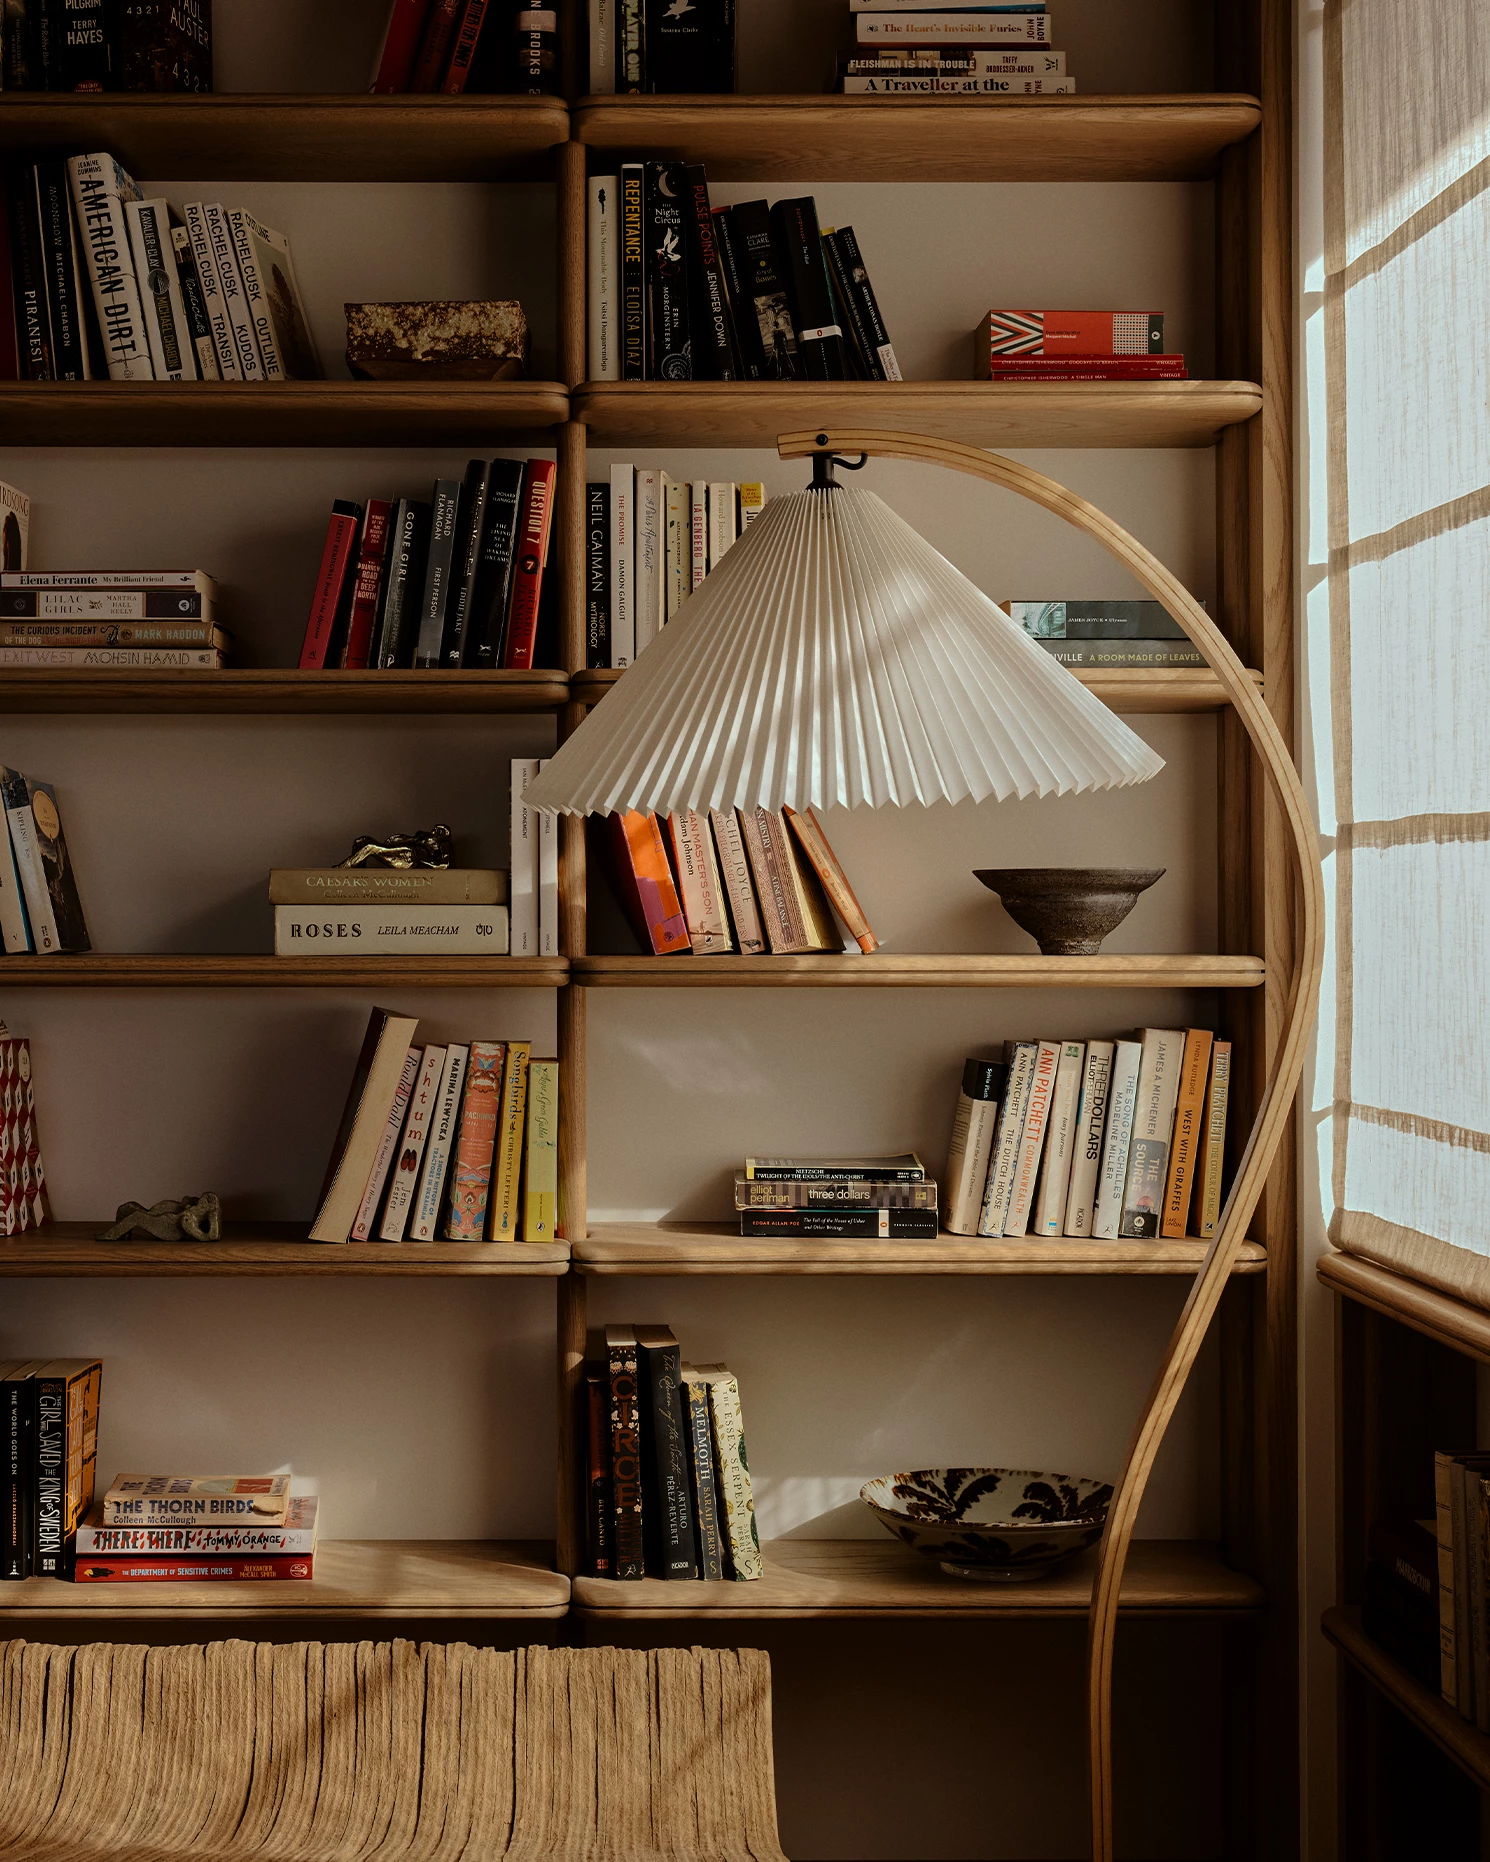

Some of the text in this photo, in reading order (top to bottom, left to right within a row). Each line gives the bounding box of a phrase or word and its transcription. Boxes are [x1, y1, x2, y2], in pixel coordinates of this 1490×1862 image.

[67, 30, 104, 45] HAYES
[72, 19, 97, 30] TERRY
[883, 24, 901, 32] The
[944, 24, 986, 32] Invisible
[989, 24, 1022, 32] Furies
[1027, 18, 1035, 39] JOHN
[1037, 16, 1045, 41] BOYNE
[530, 24, 541, 75] BROOKS
[850, 60, 976, 70] FLEISHMAN IS IN TROUBLE
[1002, 56, 1018, 64] TAFFY
[865, 79, 1009, 91] A Traveller at the
[986, 65, 1035, 73] BRODESSER-AKNER
[654, 217, 681, 225] Circus
[655, 208, 680, 218] Night
[49, 184, 72, 347] MOONGLOW MICHAEL CHABON
[80, 180, 137, 352] AMERICAN DIRT
[625, 179, 643, 366] REPENTANCE ELOÍSA DÍAZ
[693, 185, 727, 348] PULSE POINTS JENNIFER DOWN
[186, 206, 207, 256] RACHEL
[199, 261, 217, 297] CUSK
[213, 313, 235, 370] TRANSIT
[207, 208, 256, 371] RACHEL CUSK KUDOS
[231, 212, 279, 374] RACHEL CUSK OUTLINE
[24, 289, 43, 363] PIRANESI
[663, 286, 671, 350] MORGENSTERN
[434, 493, 446, 540] FLANAGAN
[444, 499, 455, 537] RICHARD
[528, 481, 547, 534] QUESTION
[397, 511, 415, 583] GONE GIRL
[591, 491, 604, 592] NEIL GAIMAN
[20, 575, 49, 585] Elena
[52, 575, 98, 585] Ferrante
[430, 566, 442, 619] FIRST PERSON
[45, 605, 83, 614] GIRLS
[46, 595, 83, 603] LILAC
[4, 637, 41, 645] OF THE DOG
[11, 626, 97, 635] THE CURIOUS INCIDENT
[135, 629, 205, 639] MARK HADDON
[590, 601, 598, 649] MYTHOLOGY
[2, 652, 190, 665] EXIT WEST MOHSIN HAMID
[1170, 653, 1200, 661] LEAVES
[290, 923, 460, 938] ROSES LEILA MEACHAM
[388, 1055, 418, 1129] Roald Dahl
[438, 1058, 461, 1141] MARINA LEWYCKA
[510, 1051, 526, 1120] Songbirds
[1210, 1052, 1228, 1145] TERRY PRATCHETT
[994, 1052, 1027, 1210] ANN PATCHETT THE DUTCH HOUSE
[1016, 1048, 1055, 1214] ANN PATCHETT COMMONWEALTH
[1105, 1092, 1123, 1180] MADELINE MILLER
[1113, 1075, 1136, 1200] THE SONG OF ACHILLES
[1171, 1110, 1193, 1212] WEST WITH GIRAFFES
[750, 1185, 773, 1194] elliot
[750, 1193, 790, 1204] perlman
[809, 1189, 870, 1200] three dollars
[39, 1432, 62, 1468] SAVED
[611, 1374, 639, 1507] CIRCE
[12, 1462, 18, 1475] ON
[694, 1407, 717, 1557] MELMOTH SARAH PERRY
[39, 1476, 61, 1503] KING
[113, 1500, 254, 1514] THE THORN BIRDS
[113, 1516, 197, 1525] Colleen McCullough
[667, 1475, 679, 1546] PÉREZ-REVERTE
[678, 1491, 688, 1530] ARTURO
[39, 1510, 61, 1553] SWEDEN
[95, 1530, 192, 1550] THERE THERE
[204, 1534, 281, 1547] TOMMY ORANGE
[130, 1568, 169, 1576] DEPARTMENT
[177, 1567, 208, 1576] SENSITIVE
[210, 1567, 233, 1575] CRIMES
[243, 1564, 273, 1572] ALEXANDER
